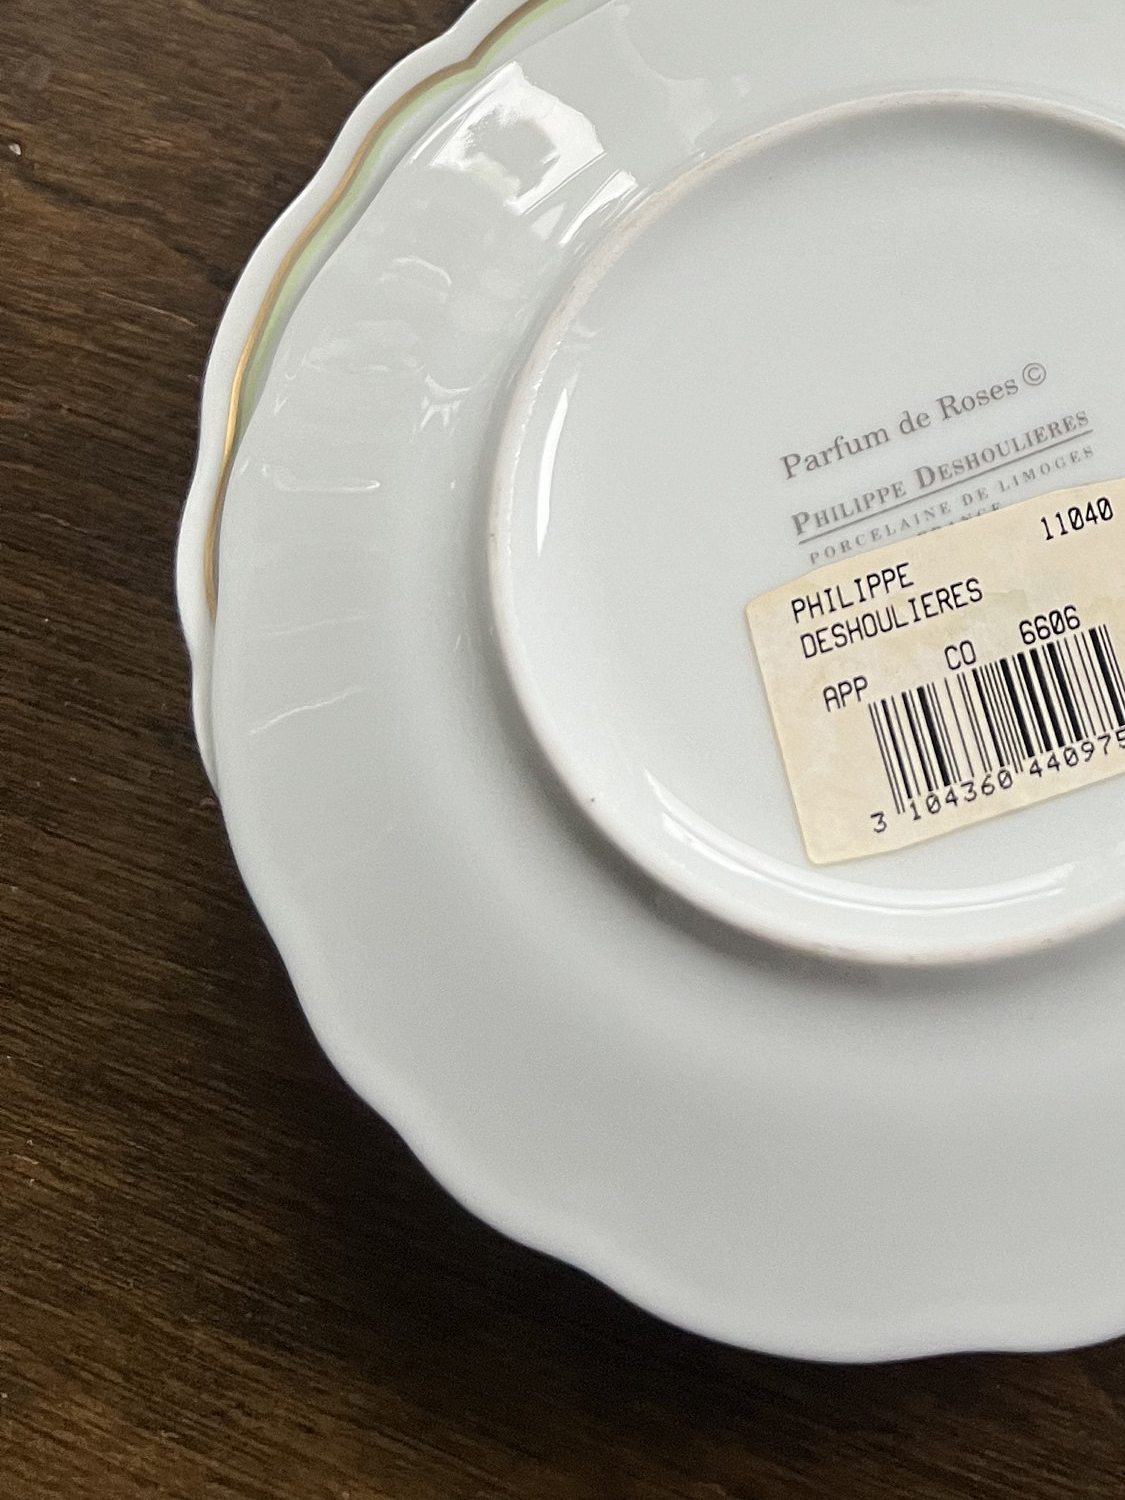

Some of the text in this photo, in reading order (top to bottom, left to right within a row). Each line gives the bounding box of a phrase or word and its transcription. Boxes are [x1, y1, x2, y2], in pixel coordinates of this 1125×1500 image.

[779, 435, 890, 480] Parfum
[899, 410, 932, 435] de
[791, 410, 1090, 536] PHILIPPE DESHOULIERES
[809, 445, 1095, 565] PORCELAINE DE LIMOGES
[1040, 496, 1114, 541] 11040
[790, 562, 914, 624] PHILIPPE
[800, 577, 983, 659] DESHOULIERES
[822, 604, 1081, 713] APP CO 6606
[870, 811, 888, 834] 3
[909, 769, 1014, 821] 104360
